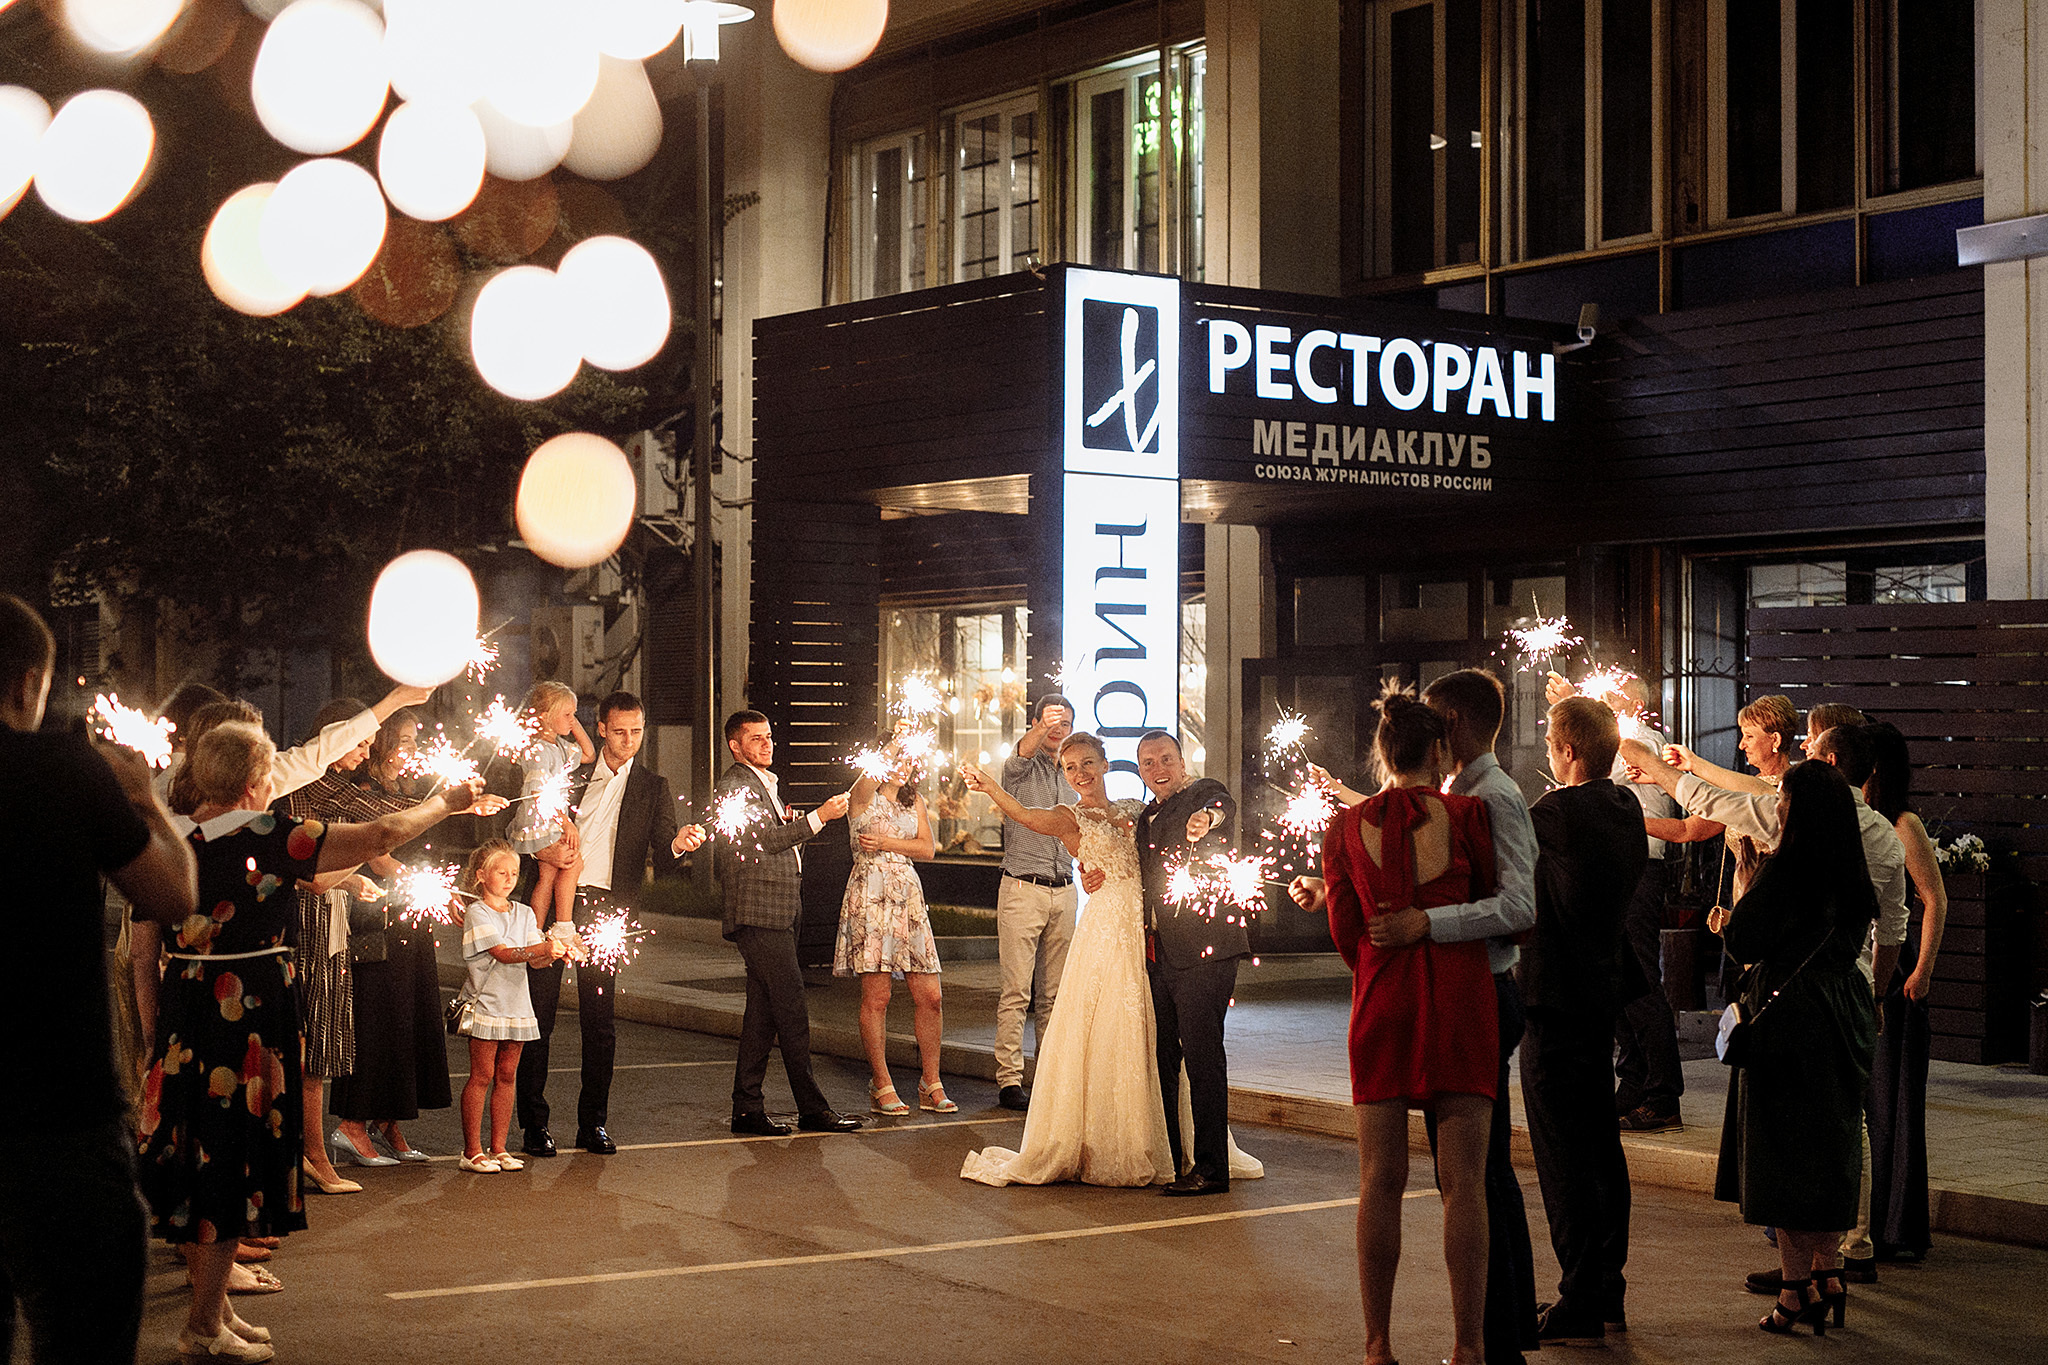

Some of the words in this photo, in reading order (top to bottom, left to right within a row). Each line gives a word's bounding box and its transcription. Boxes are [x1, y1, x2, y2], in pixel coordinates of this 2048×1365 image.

[1208, 319, 1555, 421] РЕСТОРАН
[1253, 418, 1492, 469] МЕДИАКЛУБ
[1254, 463, 1313, 481] СОЮЗА
[1315, 467, 1430, 488] ЖУРНАЛИСТОВ
[1433, 474, 1492, 492] РОССИИ
